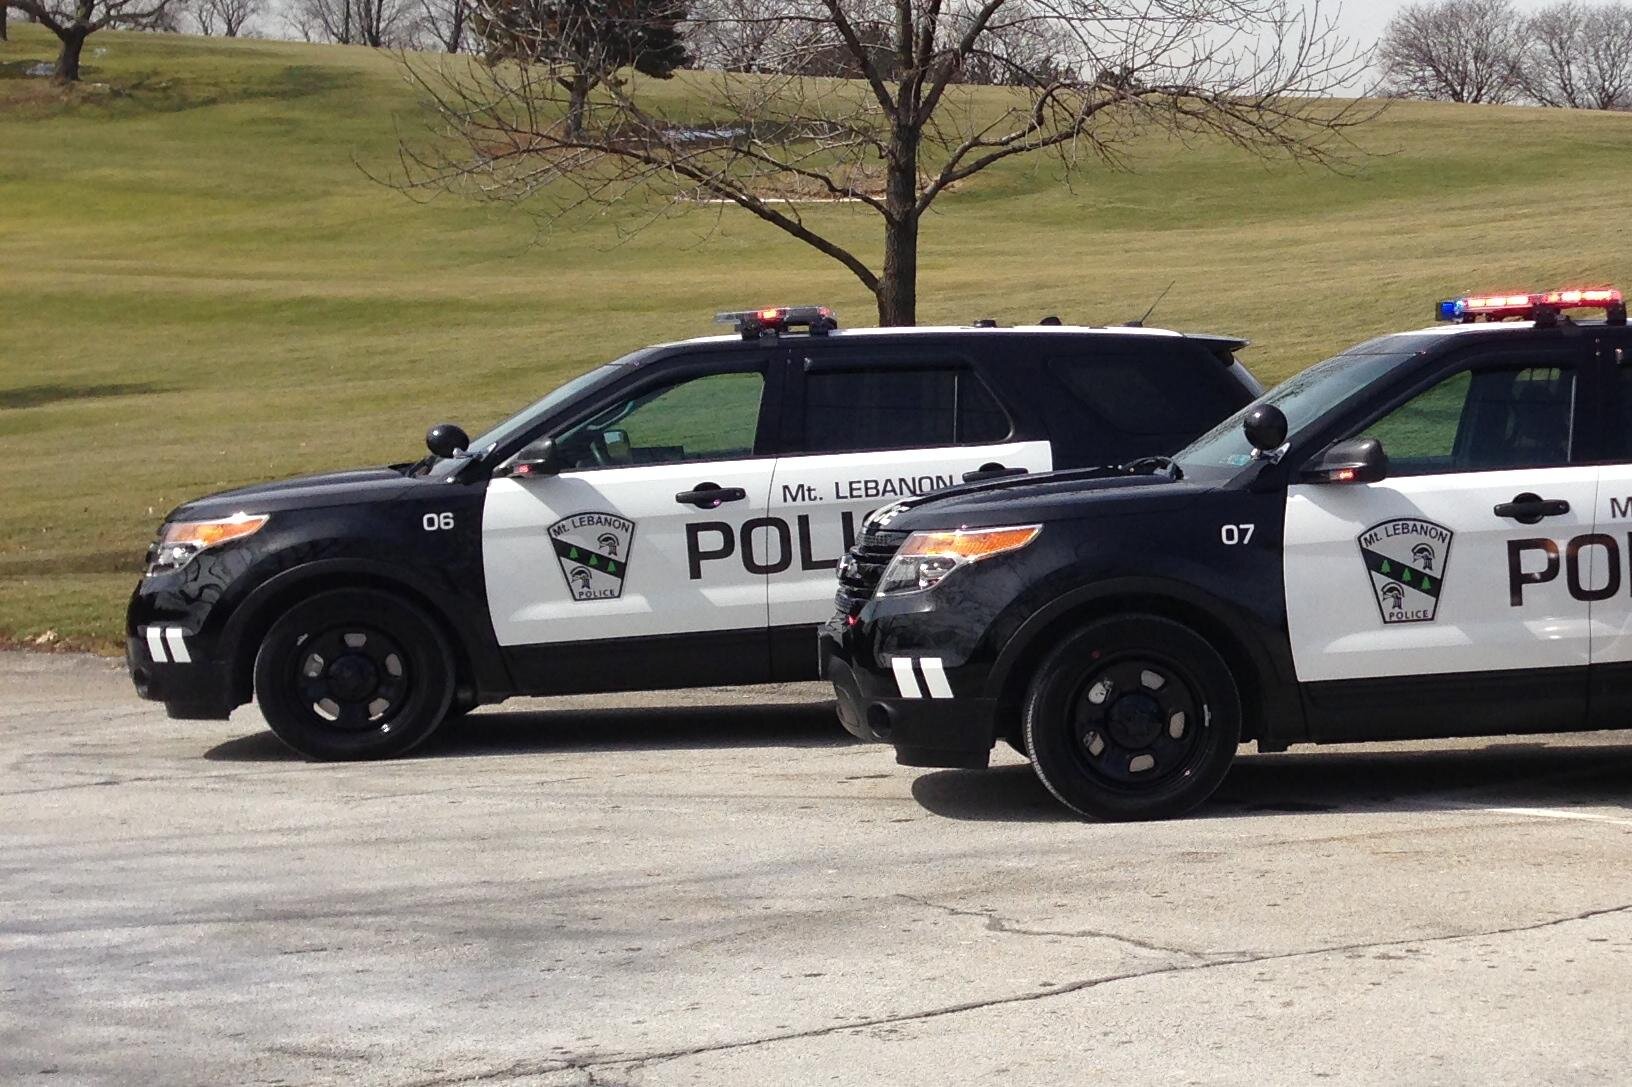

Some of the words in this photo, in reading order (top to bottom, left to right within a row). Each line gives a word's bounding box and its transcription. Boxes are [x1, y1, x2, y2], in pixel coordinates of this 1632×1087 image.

[782, 484, 823, 503] Mt.
[835, 475, 954, 500] LEBANON
[422, 512, 455, 531] 06
[552, 522, 570, 538] Mt.
[572, 515, 631, 534] LEBANON
[685, 509, 877, 580] POLI
[1221, 524, 1255, 545] 07
[1364, 532, 1383, 548] Mt.
[1385, 522, 1448, 544] LEBANON
[578, 589, 615, 599] POLICE
[1389, 609, 1429, 620] POLICE
